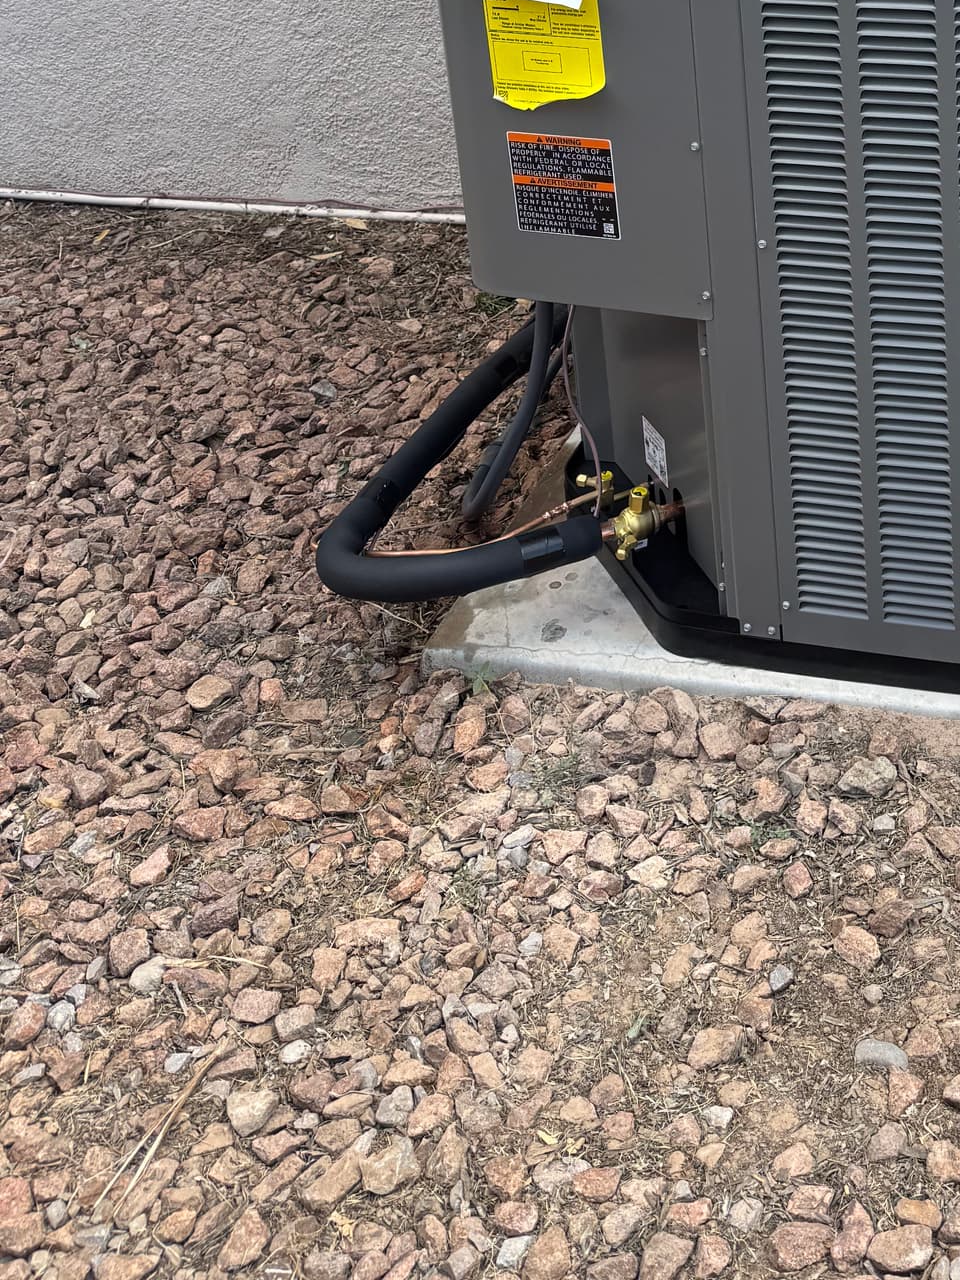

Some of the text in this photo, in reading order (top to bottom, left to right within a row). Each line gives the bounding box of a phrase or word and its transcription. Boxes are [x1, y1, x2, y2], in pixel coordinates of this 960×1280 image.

[545, 136, 581, 146] WARNING
[511, 149, 546, 157] PROPERLY
[562, 154, 610, 163] ACCORDANCE
[535, 157, 569, 165] FEDERAL
[514, 169, 560, 178] REFRIGERANT
[568, 167, 612, 176] FLAMMABLE
[537, 178, 597, 189] AVERTISSEMENT
[517, 192, 587, 203] CORRECTEMENT
[521, 224, 575, 234] INFLAMMABLE
